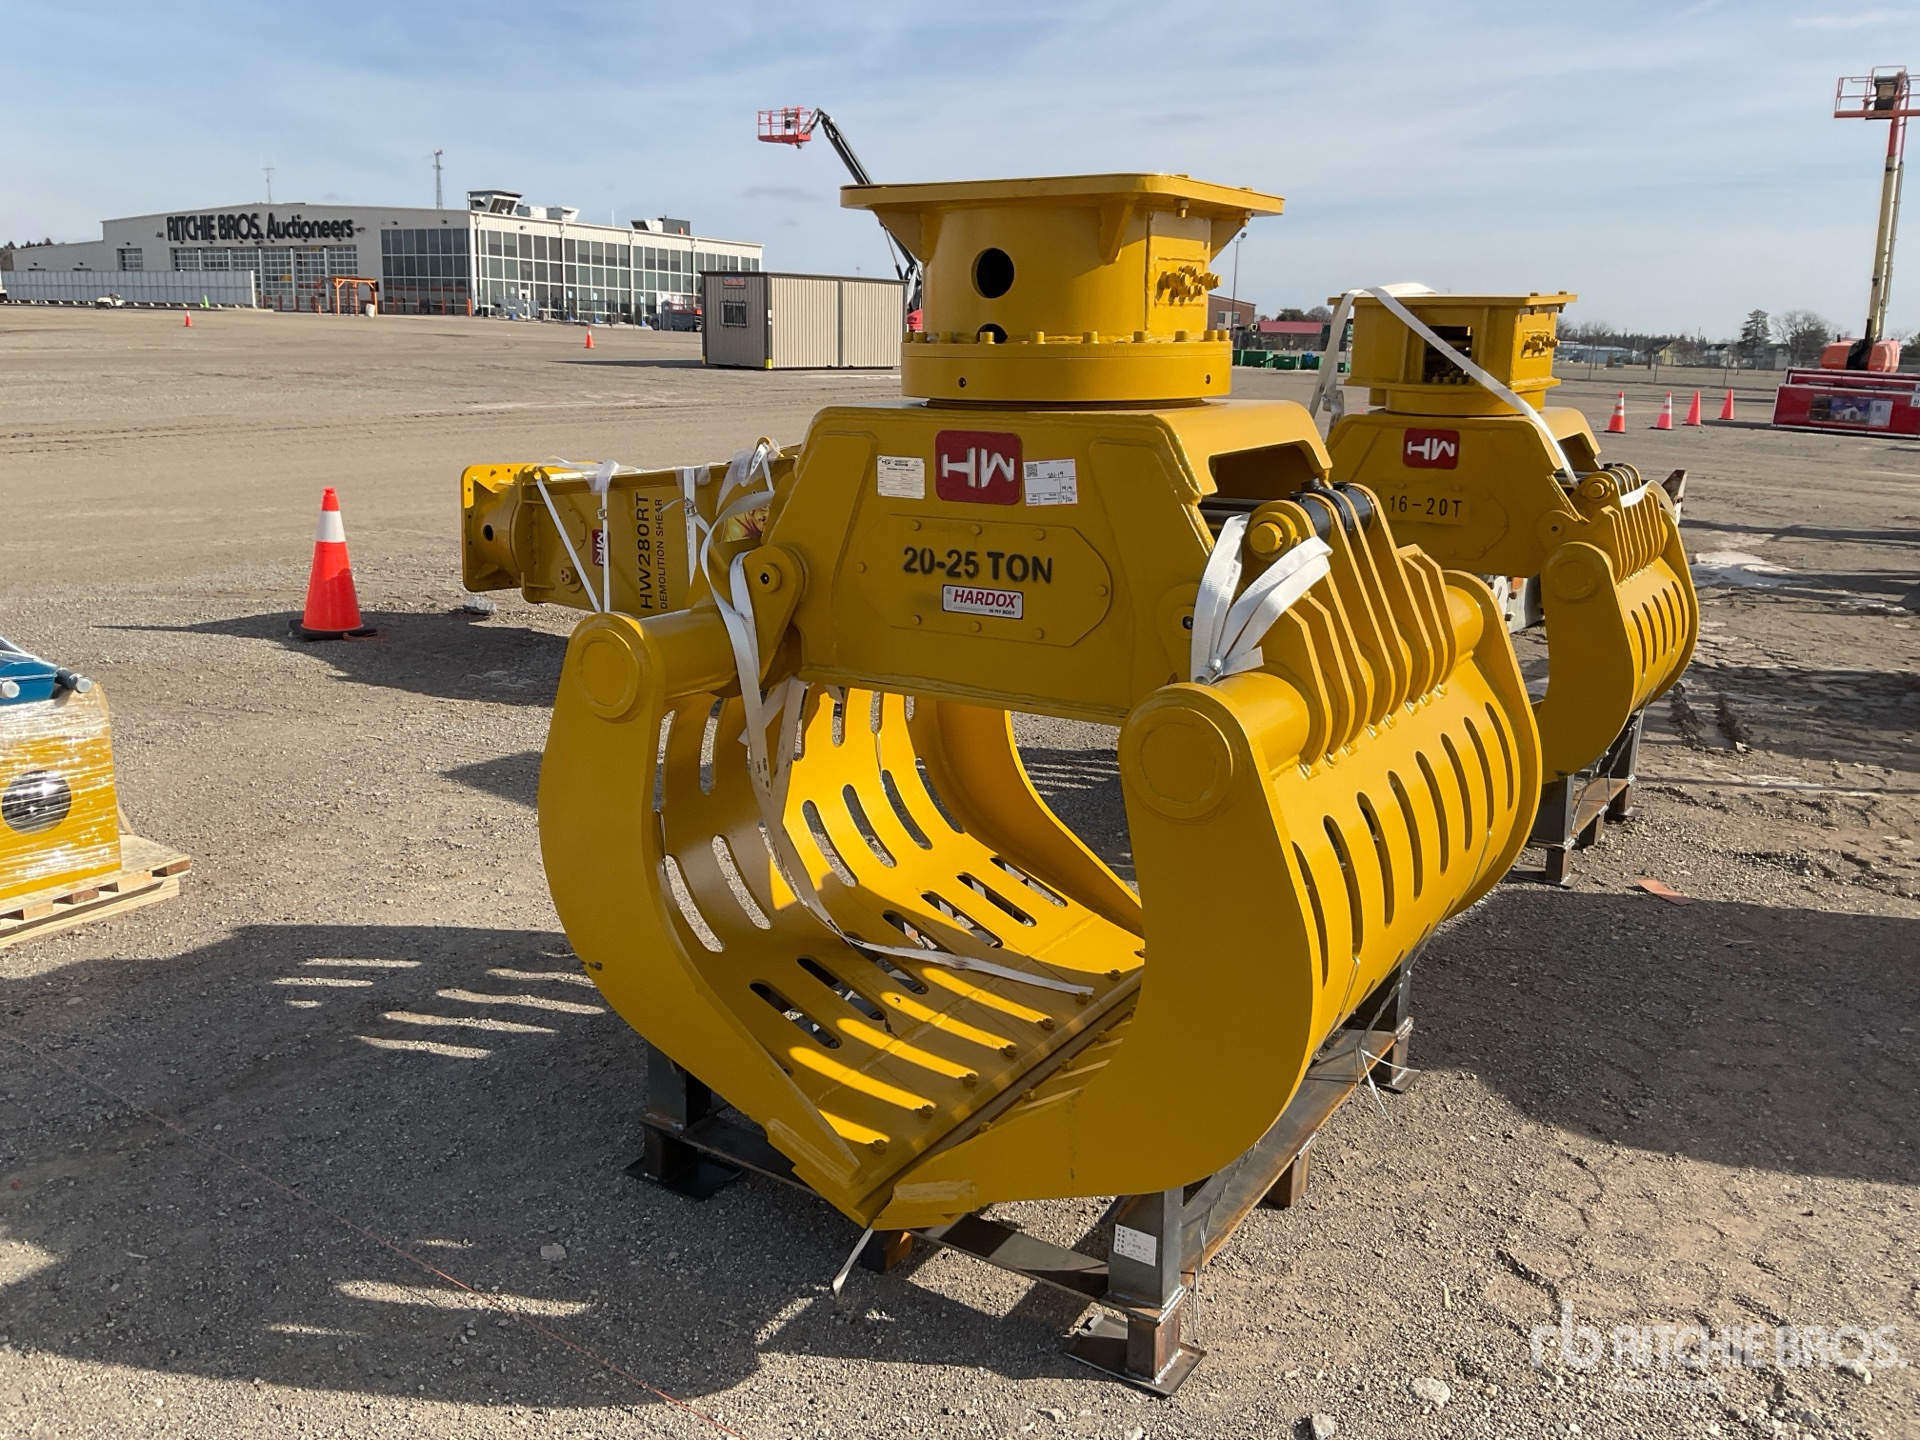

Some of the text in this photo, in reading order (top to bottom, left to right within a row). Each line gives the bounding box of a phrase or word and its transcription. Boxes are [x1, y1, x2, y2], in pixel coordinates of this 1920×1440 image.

[167, 212, 355, 241] RITCHIE BROS. Auctioneers
[1390, 495, 1462, 517] 16-20T
[635, 492, 653, 609] HW280RT
[655, 498, 668, 609] DEMOLITION SHEAR
[903, 546, 1052, 584] 20-25 TON
